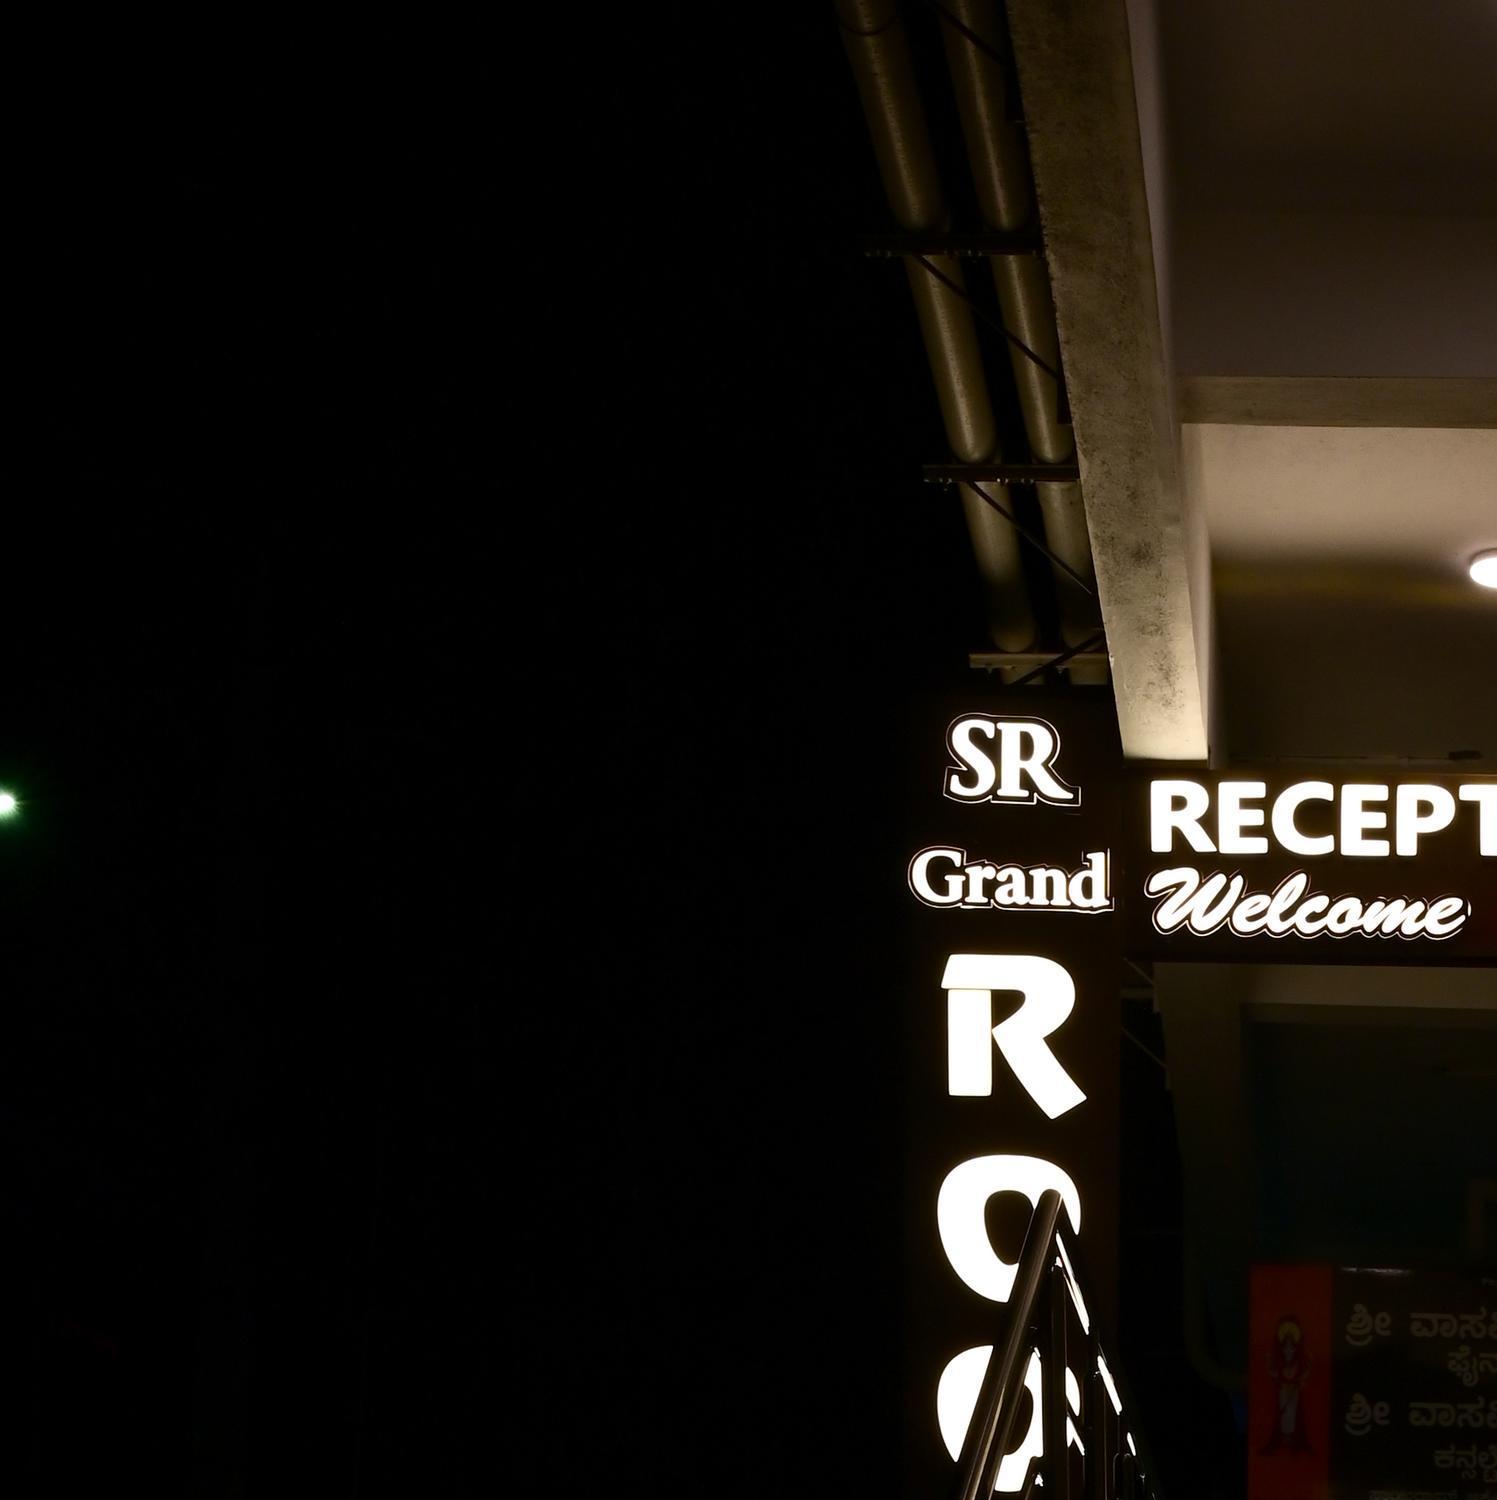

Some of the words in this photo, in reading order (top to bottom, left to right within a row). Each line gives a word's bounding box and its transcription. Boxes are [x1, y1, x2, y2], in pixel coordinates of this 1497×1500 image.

[946, 714, 1079, 806] SR
[909, 847, 1114, 913] Grand
[1145, 866, 1470, 940] Welcome
[1345, 1303, 1392, 1346] ಶ್ರೀ
[1345, 1392, 1391, 1436] ಶ್ರೀ
